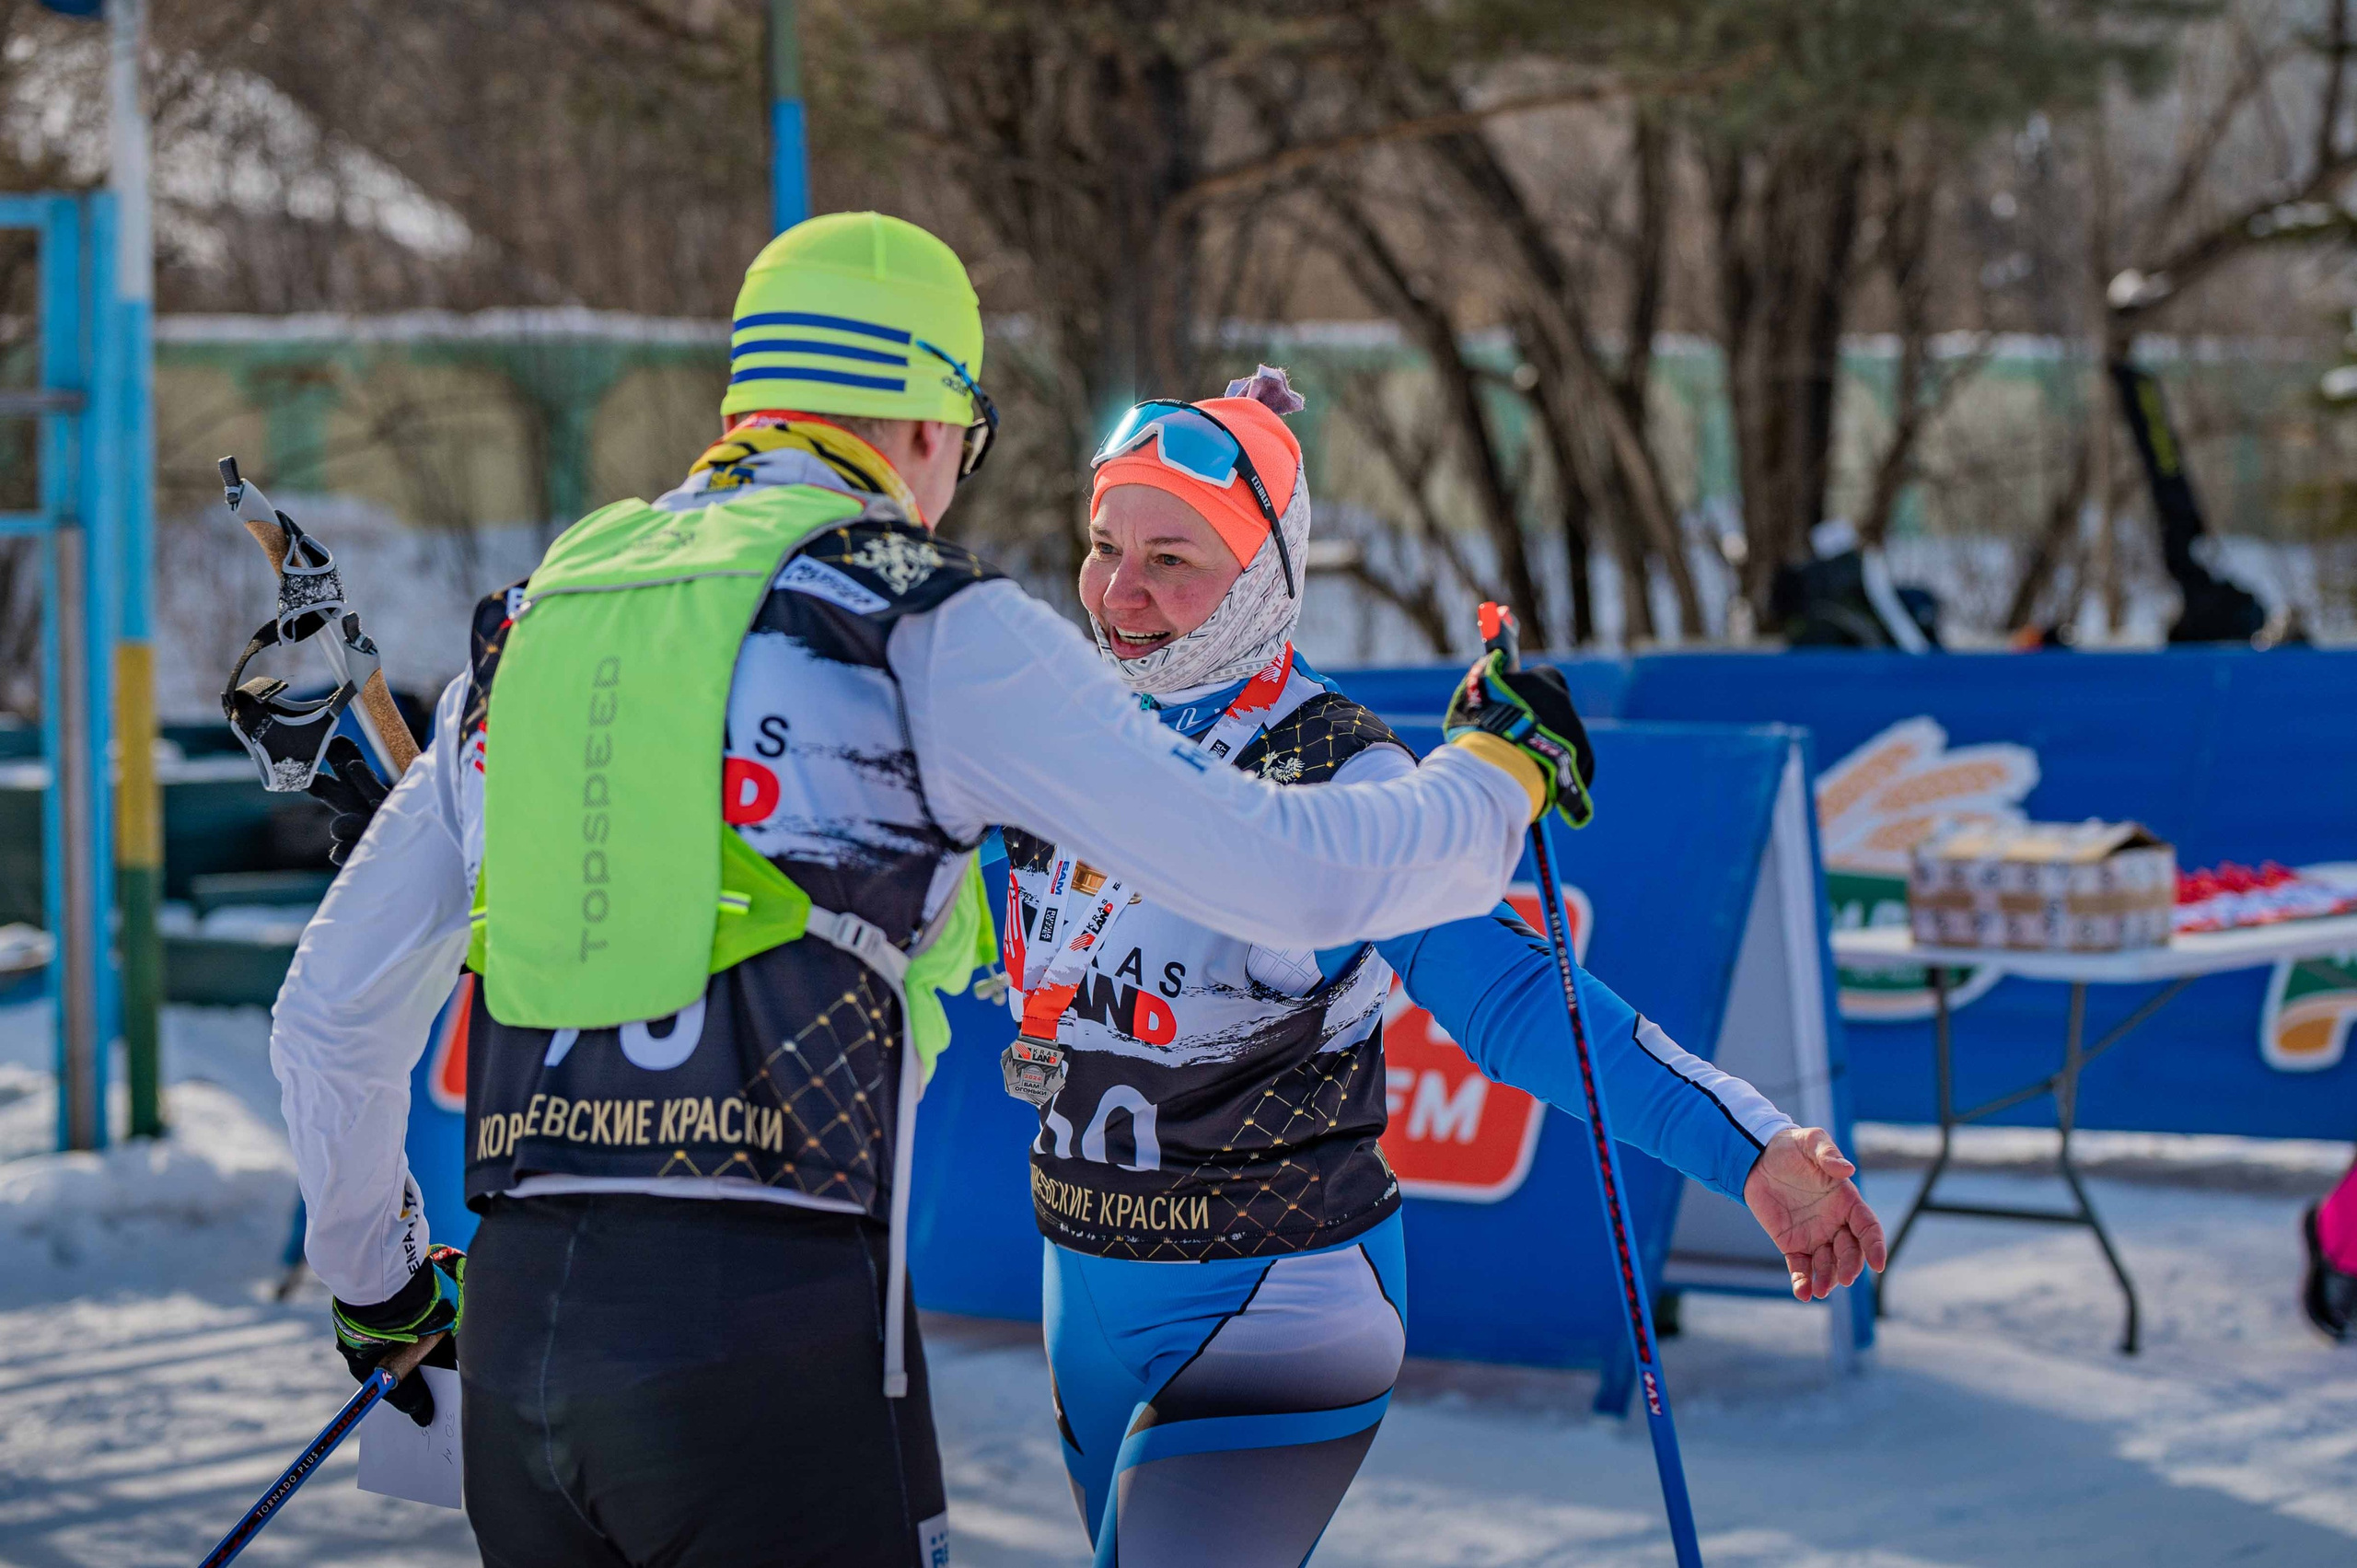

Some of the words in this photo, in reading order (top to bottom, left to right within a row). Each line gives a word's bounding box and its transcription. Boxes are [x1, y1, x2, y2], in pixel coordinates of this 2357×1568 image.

[1258, 487, 1271, 510] BLIZ
[1086, 899, 1109, 930] KRAS
[1091, 902, 1113, 935] LAND
[1032, 1053, 1057, 1064] LAND
[1033, 1048, 1058, 1057] KRAS
[658, 1097, 784, 1153] КРАСКИ
[1098, 1191, 1210, 1231] КРАСКИ
[256, 1474, 296, 1517] TORNADO
[297, 1451, 319, 1473] PLUS
[326, 1407, 360, 1443] CARBON
